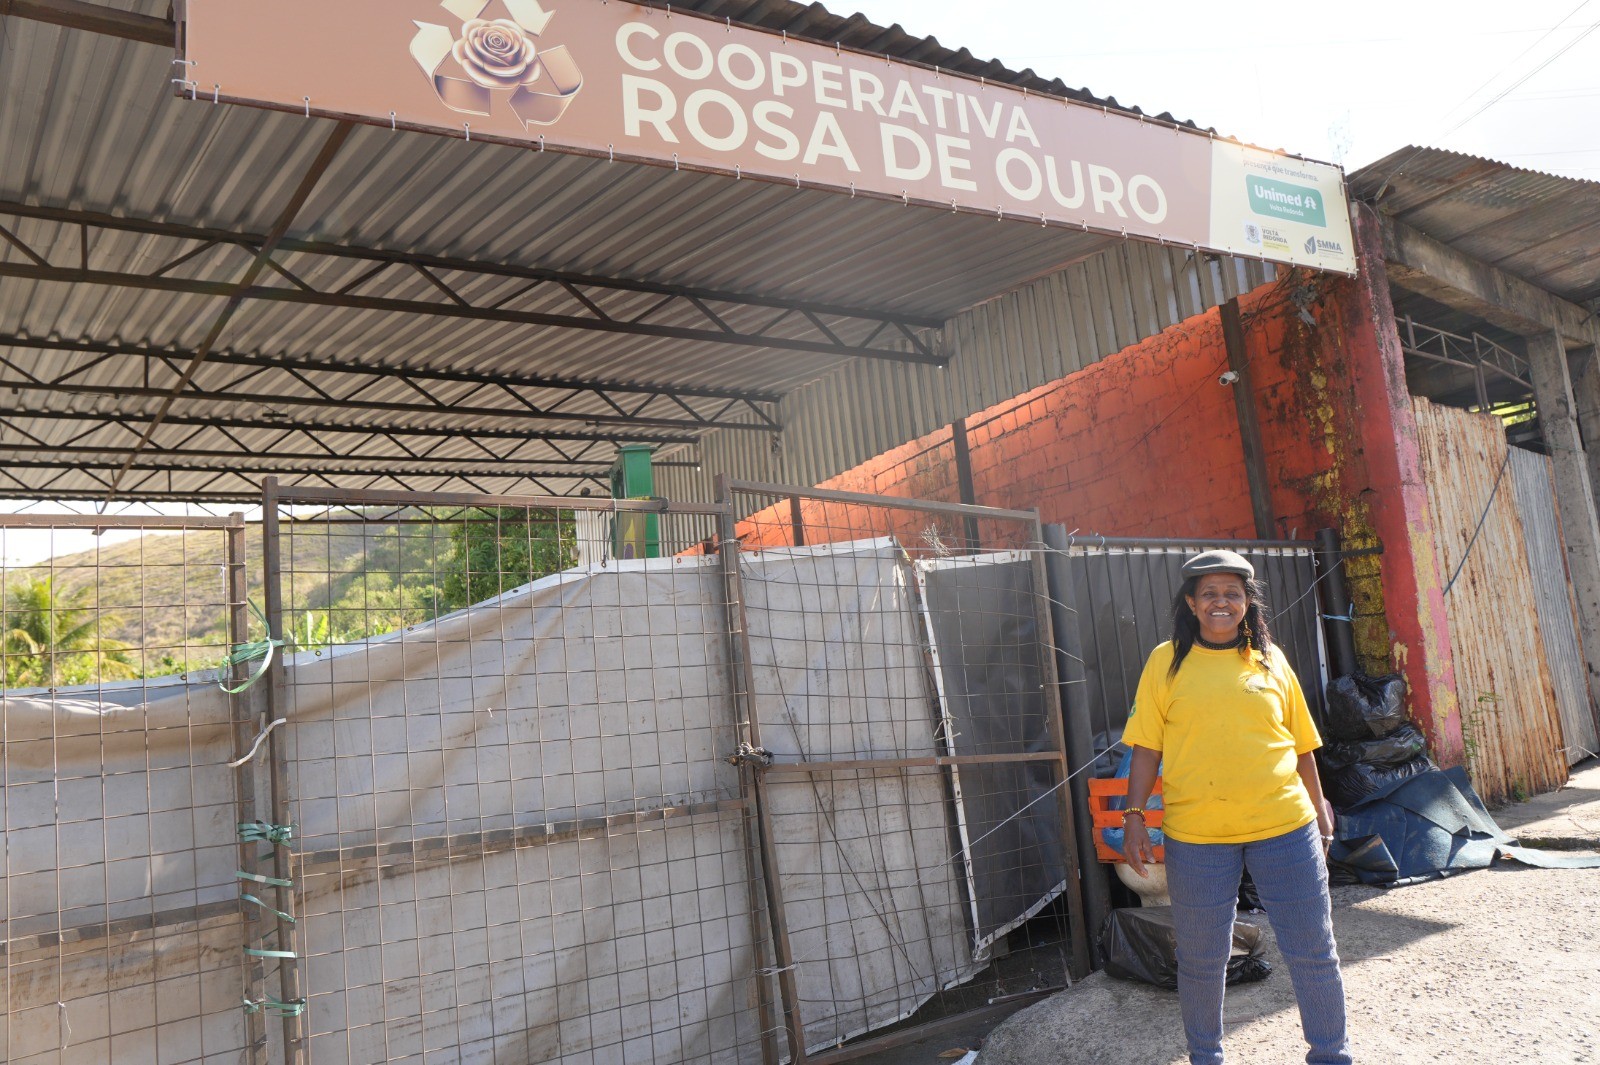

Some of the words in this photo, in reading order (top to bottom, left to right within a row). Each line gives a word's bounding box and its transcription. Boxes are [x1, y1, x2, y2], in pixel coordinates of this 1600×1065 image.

[615, 22, 1041, 148] COOPERATIVA
[621, 73, 861, 173] ROSA
[878, 122, 978, 192] DE
[994, 147, 1168, 224] OURO
[1272, 166, 1284, 174] que
[1254, 185, 1302, 207] Unimed
[1283, 206, 1304, 216] Redonda
[1262, 228, 1279, 236] VOLTA
[1263, 235, 1288, 244] REDONDA
[1317, 240, 1342, 251] SMMA
